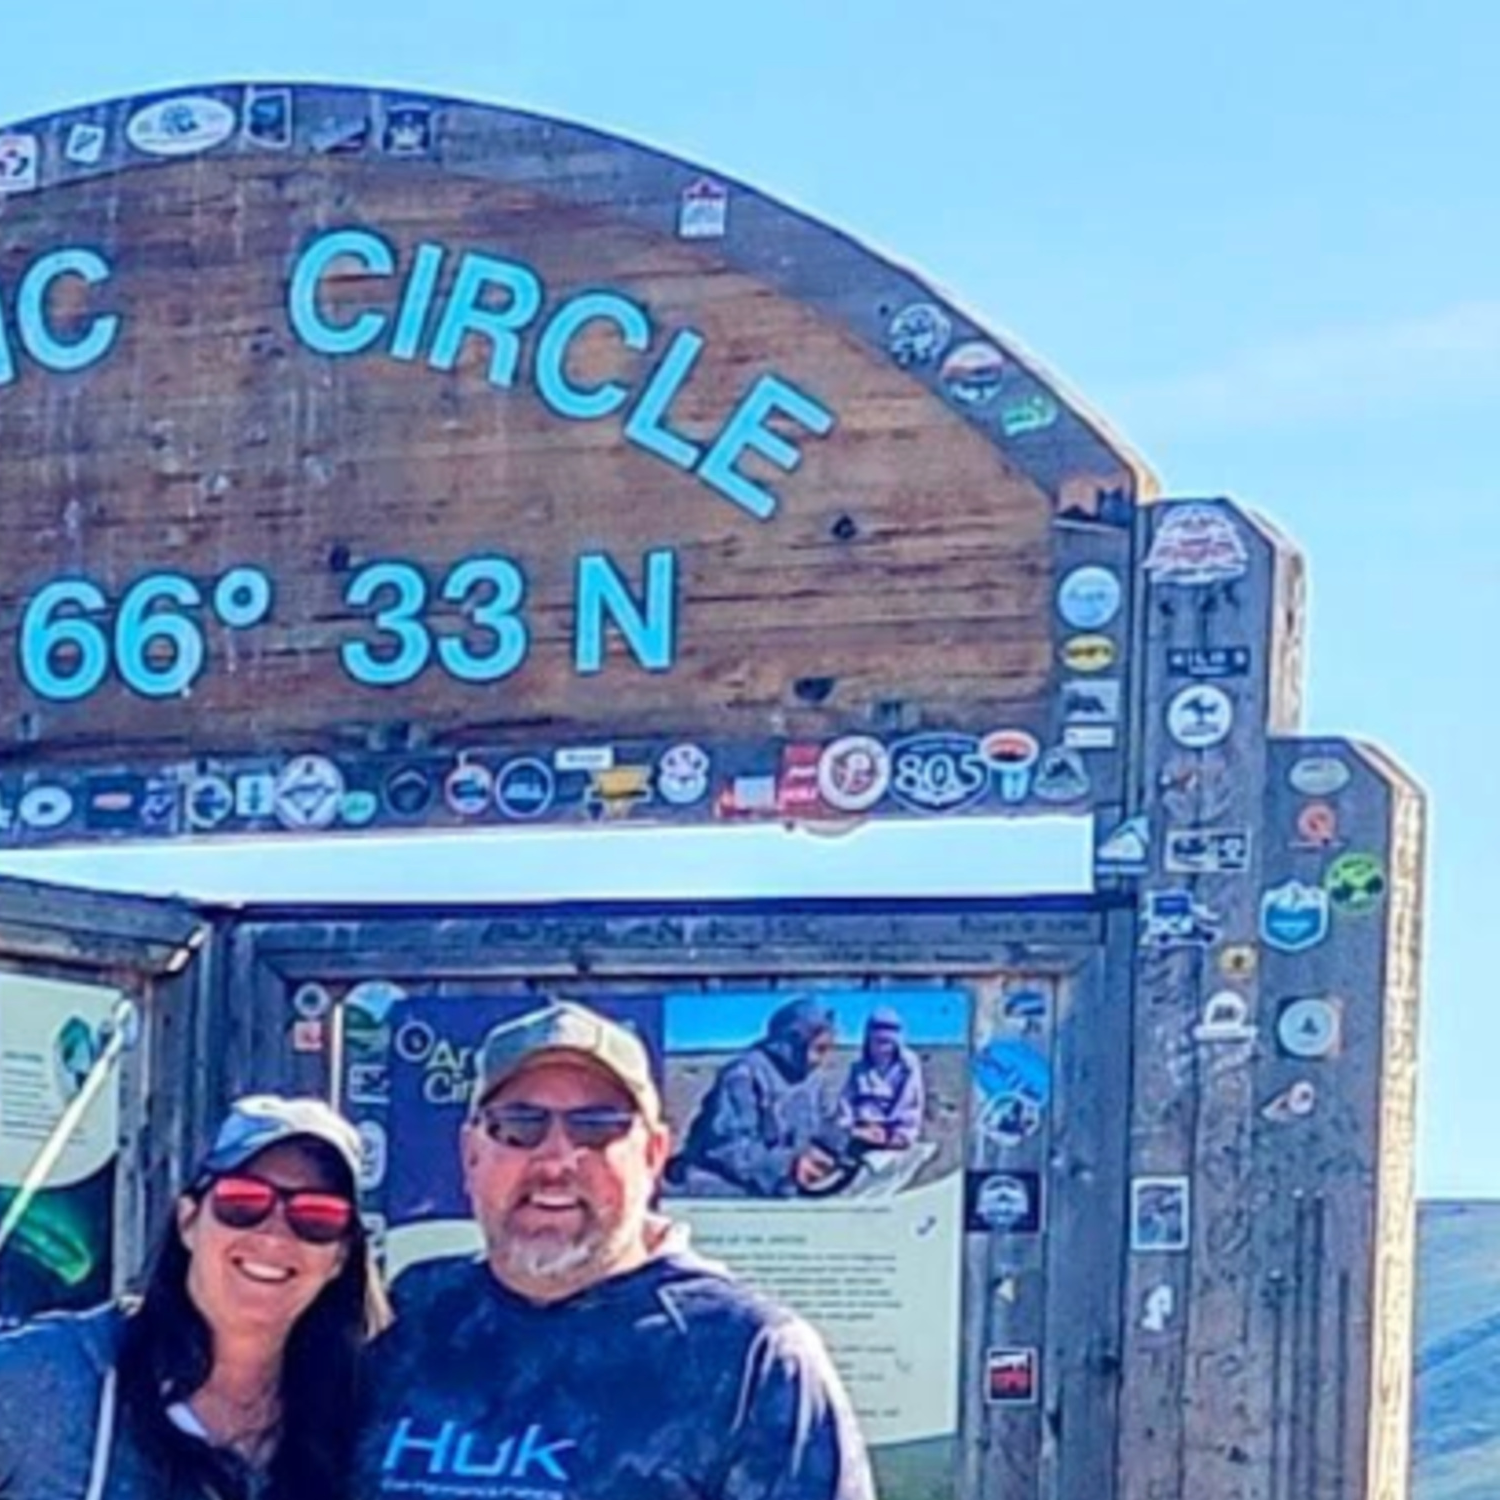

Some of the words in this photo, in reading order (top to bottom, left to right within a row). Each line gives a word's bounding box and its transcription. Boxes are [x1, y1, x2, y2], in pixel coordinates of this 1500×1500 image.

[287, 229, 834, 519] CIRCLE
[18, 567, 271, 701] 66°
[341, 556, 528, 685] 33
[574, 549, 675, 674] N
[895, 754, 985, 797] 805
